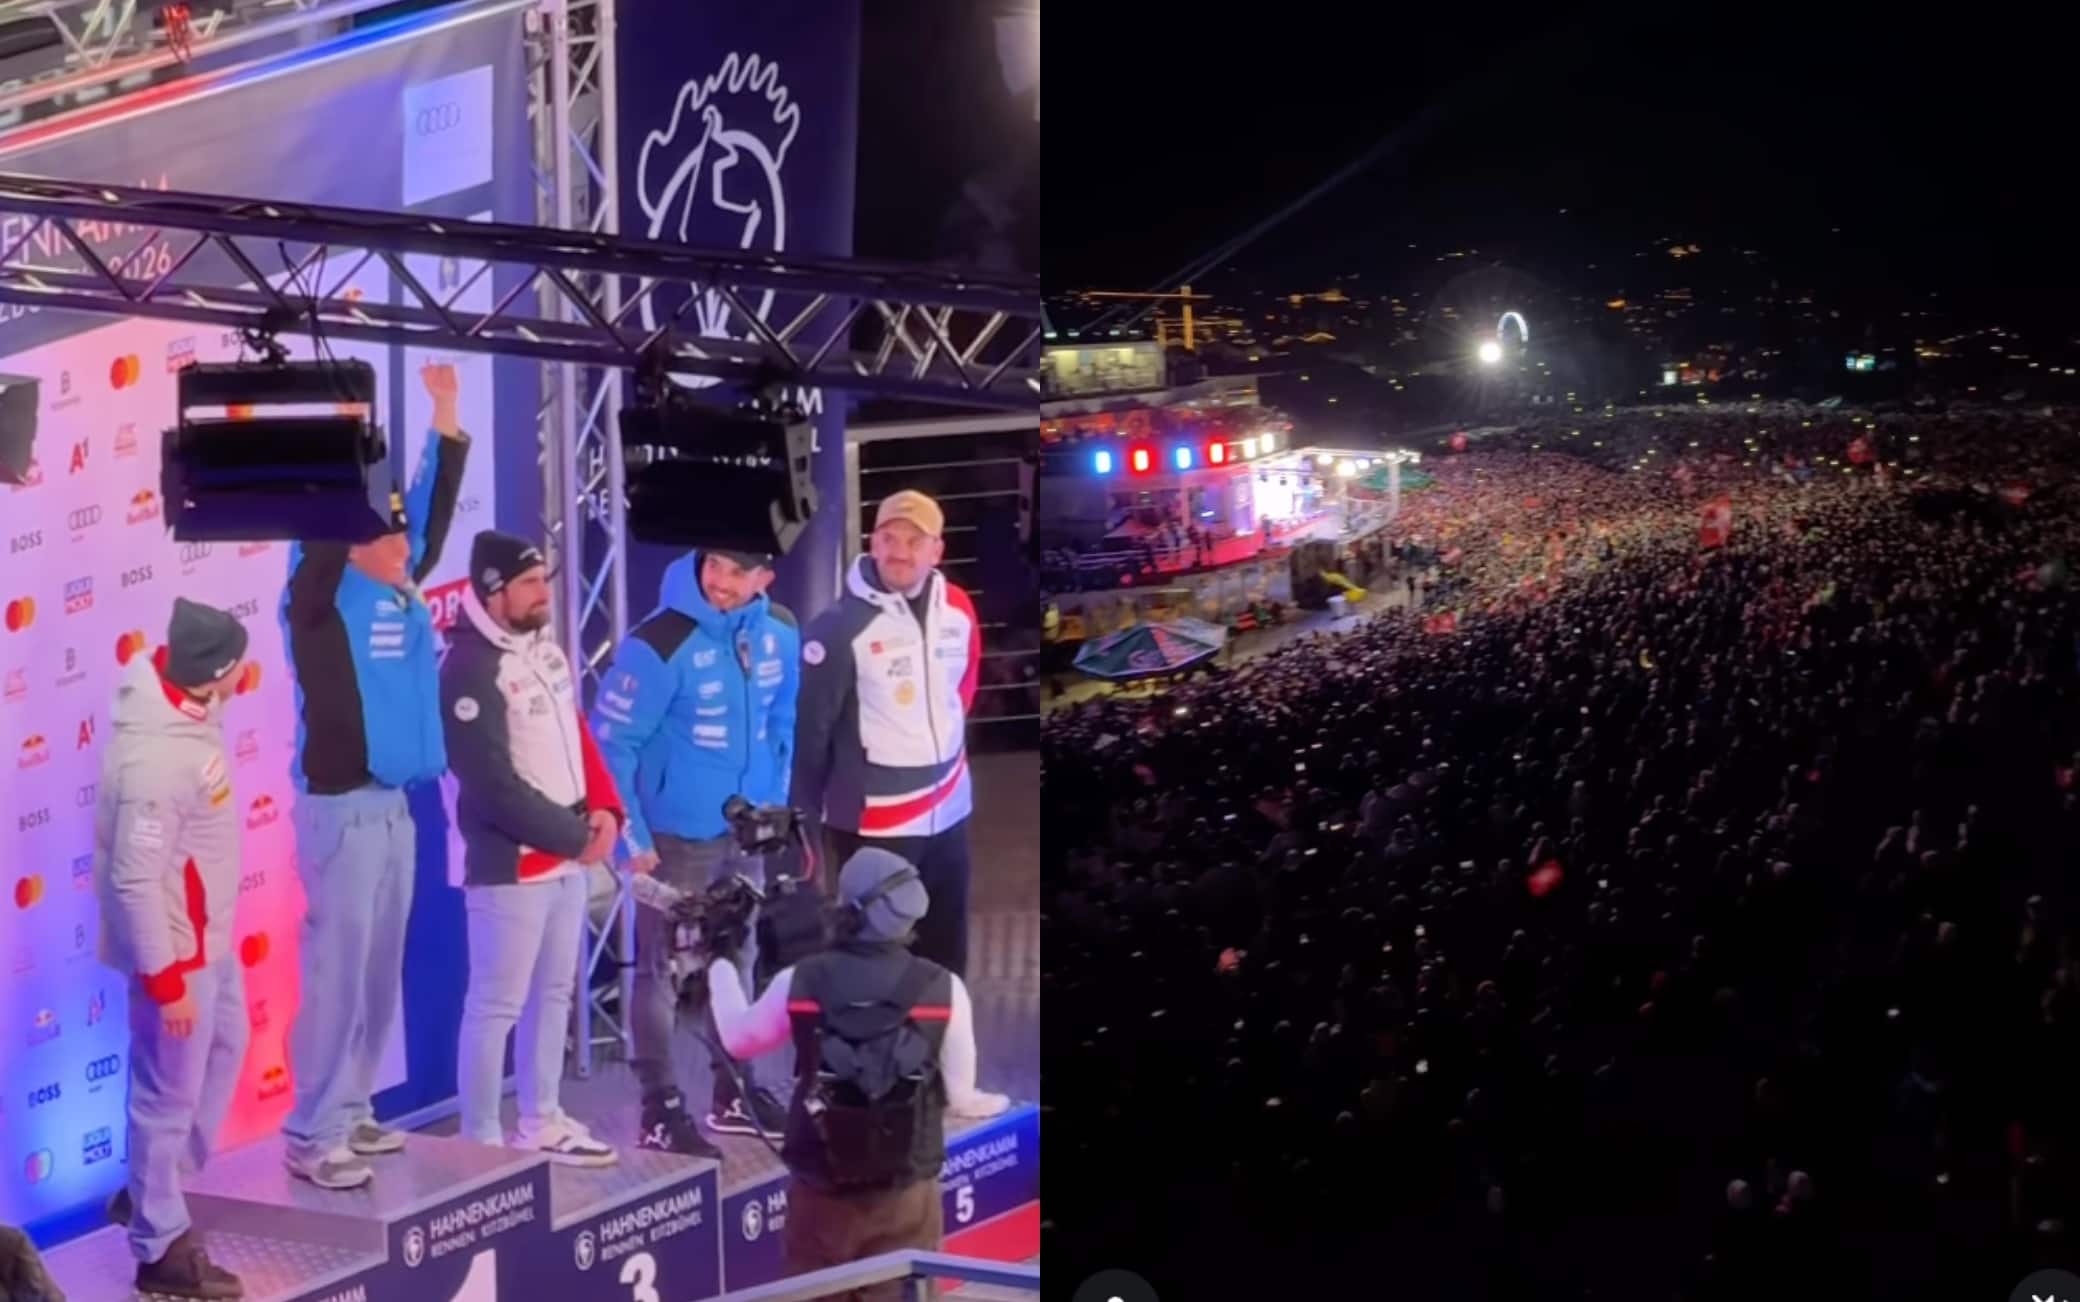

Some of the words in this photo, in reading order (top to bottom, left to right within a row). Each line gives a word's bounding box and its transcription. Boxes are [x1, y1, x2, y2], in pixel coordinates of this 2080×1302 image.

[10, 530, 43, 554] BOSS
[121, 564, 153, 589] BOSS
[18, 807, 50, 833] BOSS
[28, 1081, 62, 1109] BOSS
[430, 1182, 535, 1240] HAHNENKAMM
[600, 1186, 702, 1243] HAHNENKAMM
[956, 1184, 976, 1224] 5
[619, 1251, 660, 1302] 3
